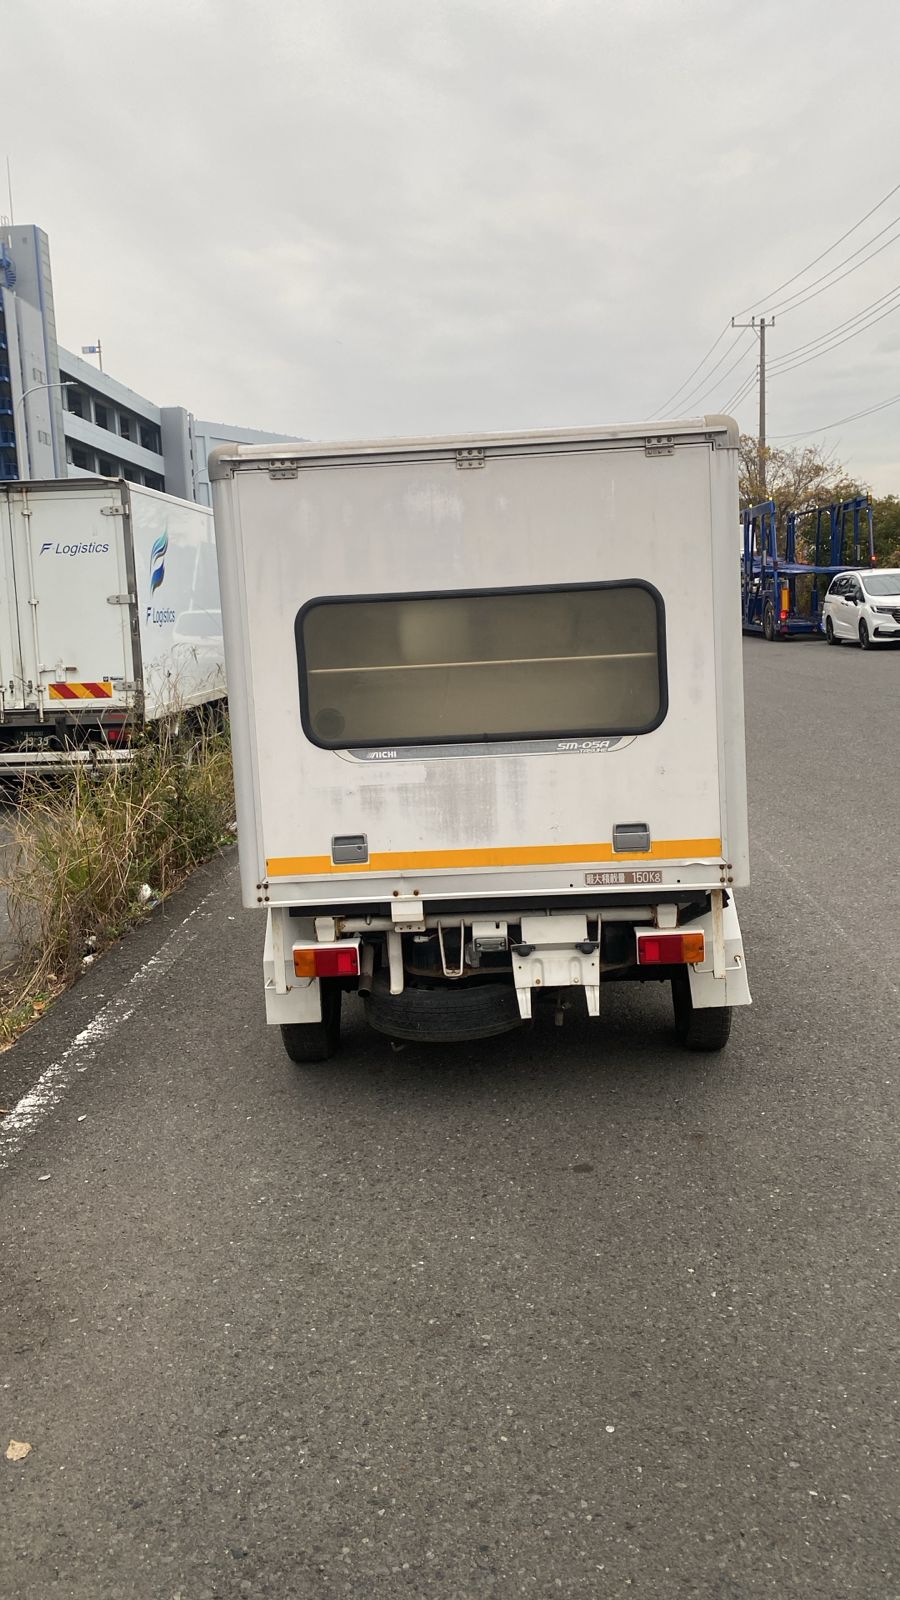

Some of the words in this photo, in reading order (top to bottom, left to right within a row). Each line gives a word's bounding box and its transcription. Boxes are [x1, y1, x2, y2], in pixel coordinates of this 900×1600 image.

[56, 542, 109, 556] Logistics
[153, 607, 175, 627] Logistics
[557, 741, 610, 750] SM-05A
[368, 751, 397, 759] AICHI
